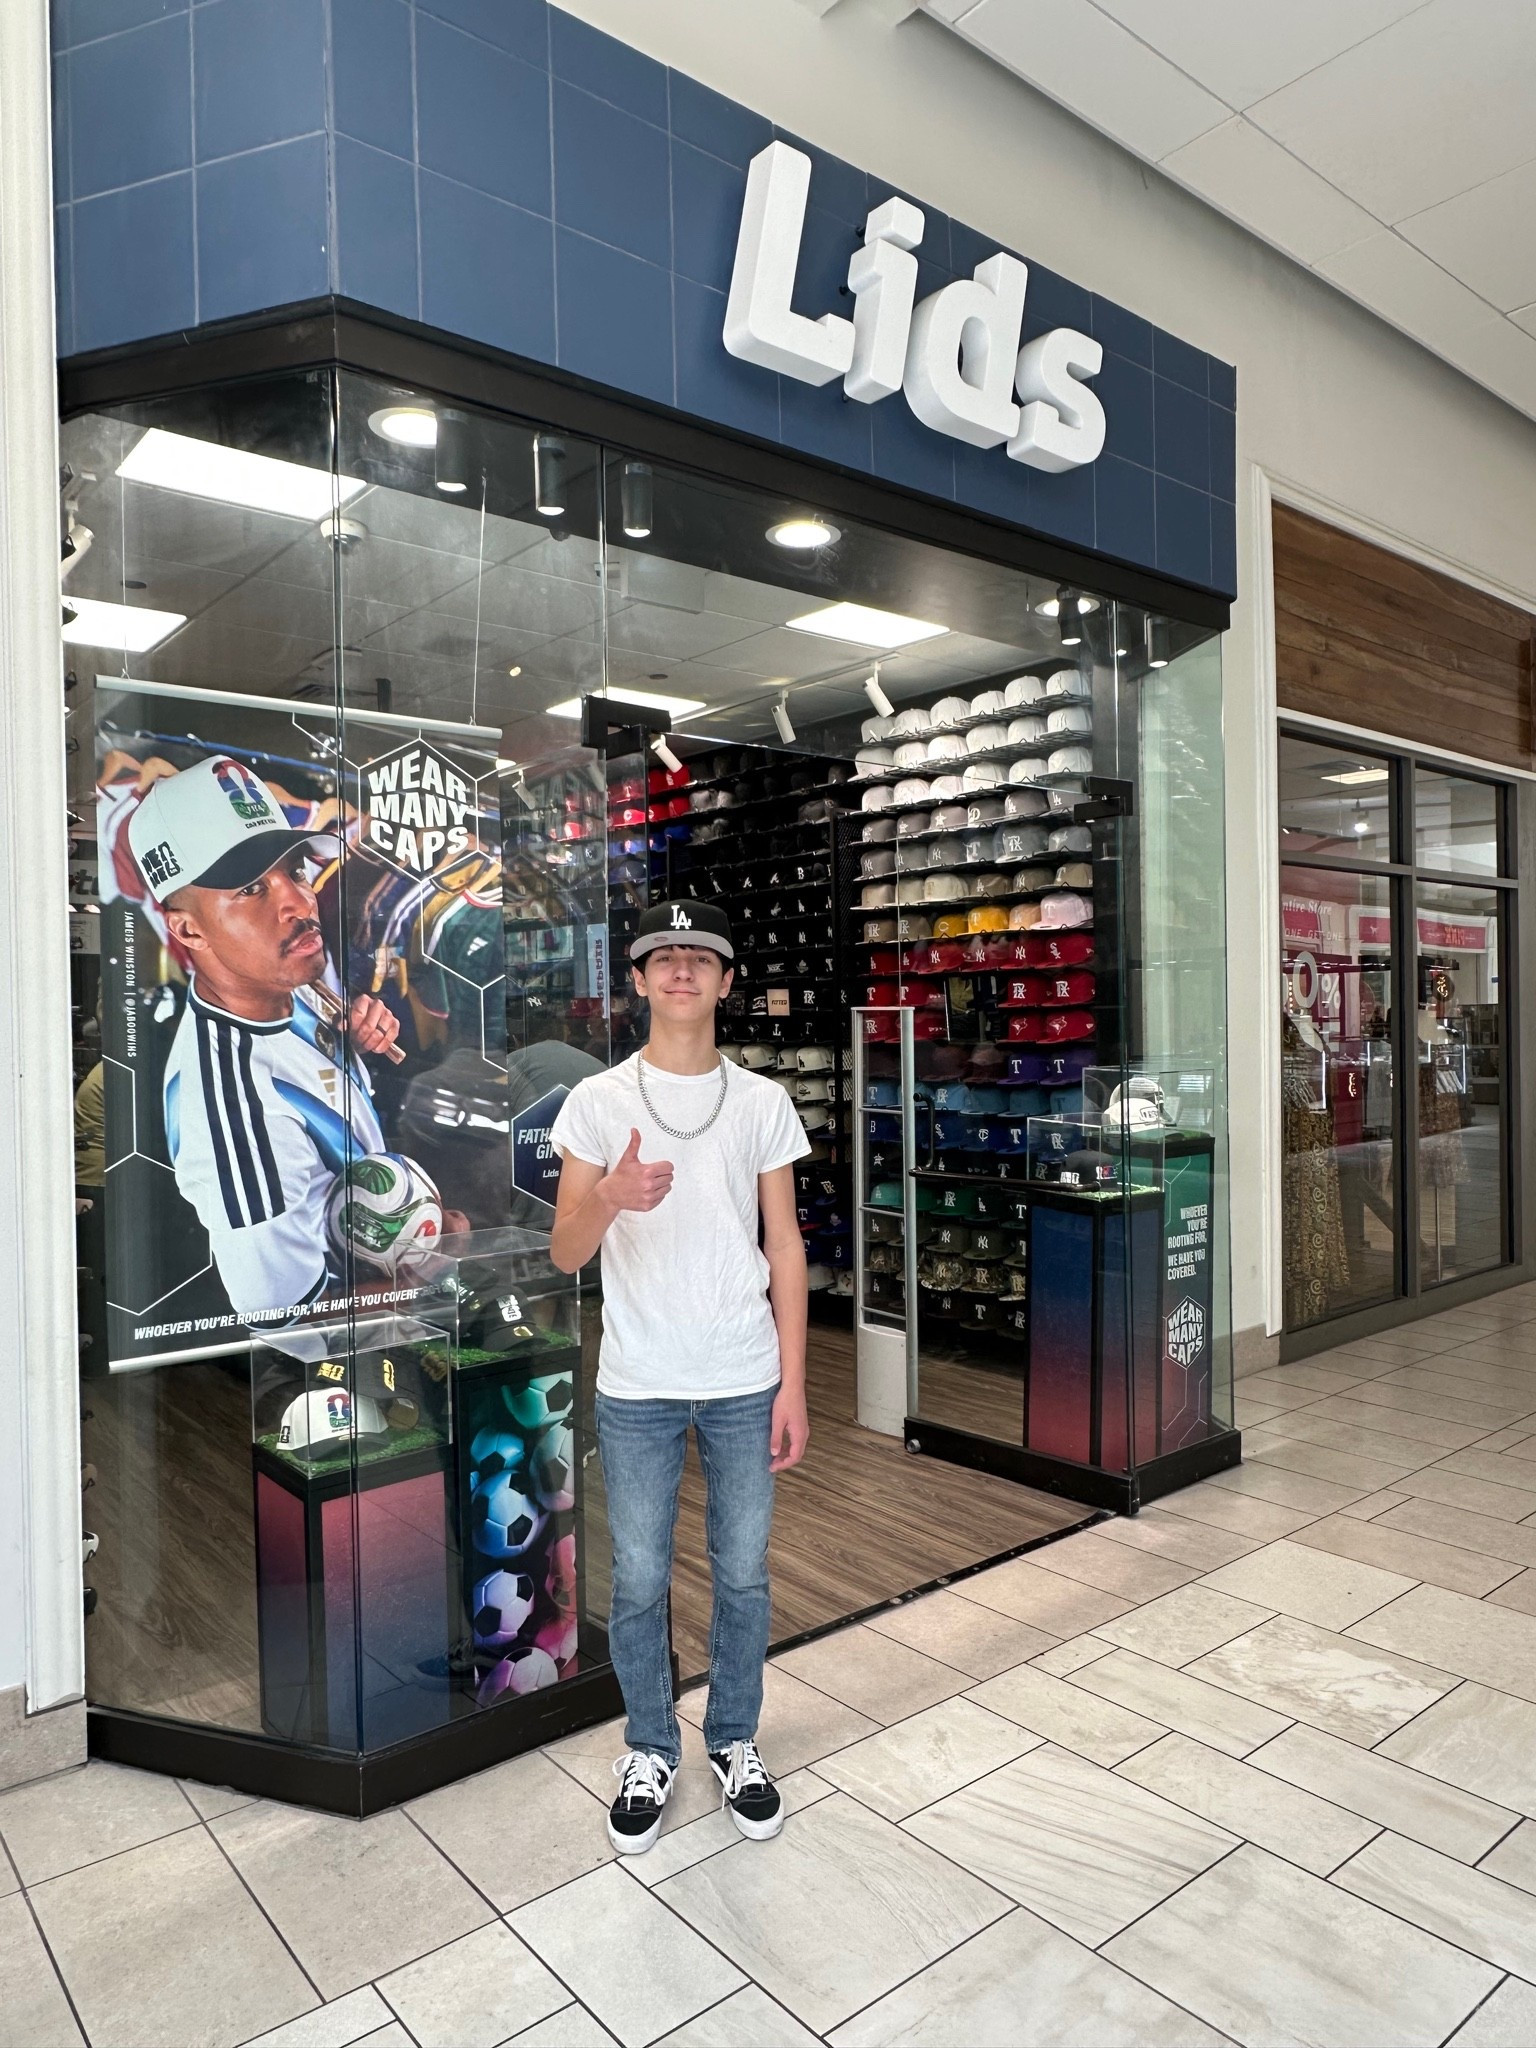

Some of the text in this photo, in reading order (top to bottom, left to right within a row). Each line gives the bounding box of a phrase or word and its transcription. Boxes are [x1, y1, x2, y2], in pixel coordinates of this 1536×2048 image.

[723, 140, 1106, 473] Lids
[368, 749, 467, 803] WEAR
[370, 792, 469, 828] MANY
[370, 820, 469, 872] CAPS
[670, 905, 692, 929] LA
[1308, 900, 1332, 915] Store
[124, 911, 134, 943] JAMEIS
[125, 946, 135, 986] WINSTON
[517, 1128, 553, 1145] FATH
[542, 1169, 560, 1178] Lids
[1168, 1233, 1194, 1249] ROOTING
[1168, 1254, 1178, 1266] WE
[134, 1321, 192, 1340] WHOEVER
[194, 1314, 236, 1331] YOU'RE
[237, 1307, 286, 1325] ROOTING
[286, 1303, 310, 1317] FOR,
[313, 1301, 329, 1313] WE
[361, 1293, 381, 1306] YOU
[1168, 1301, 1203, 1331] WEAR
[1169, 1323, 1203, 1343] MANY
[1168, 1335, 1203, 1366] CAPS
